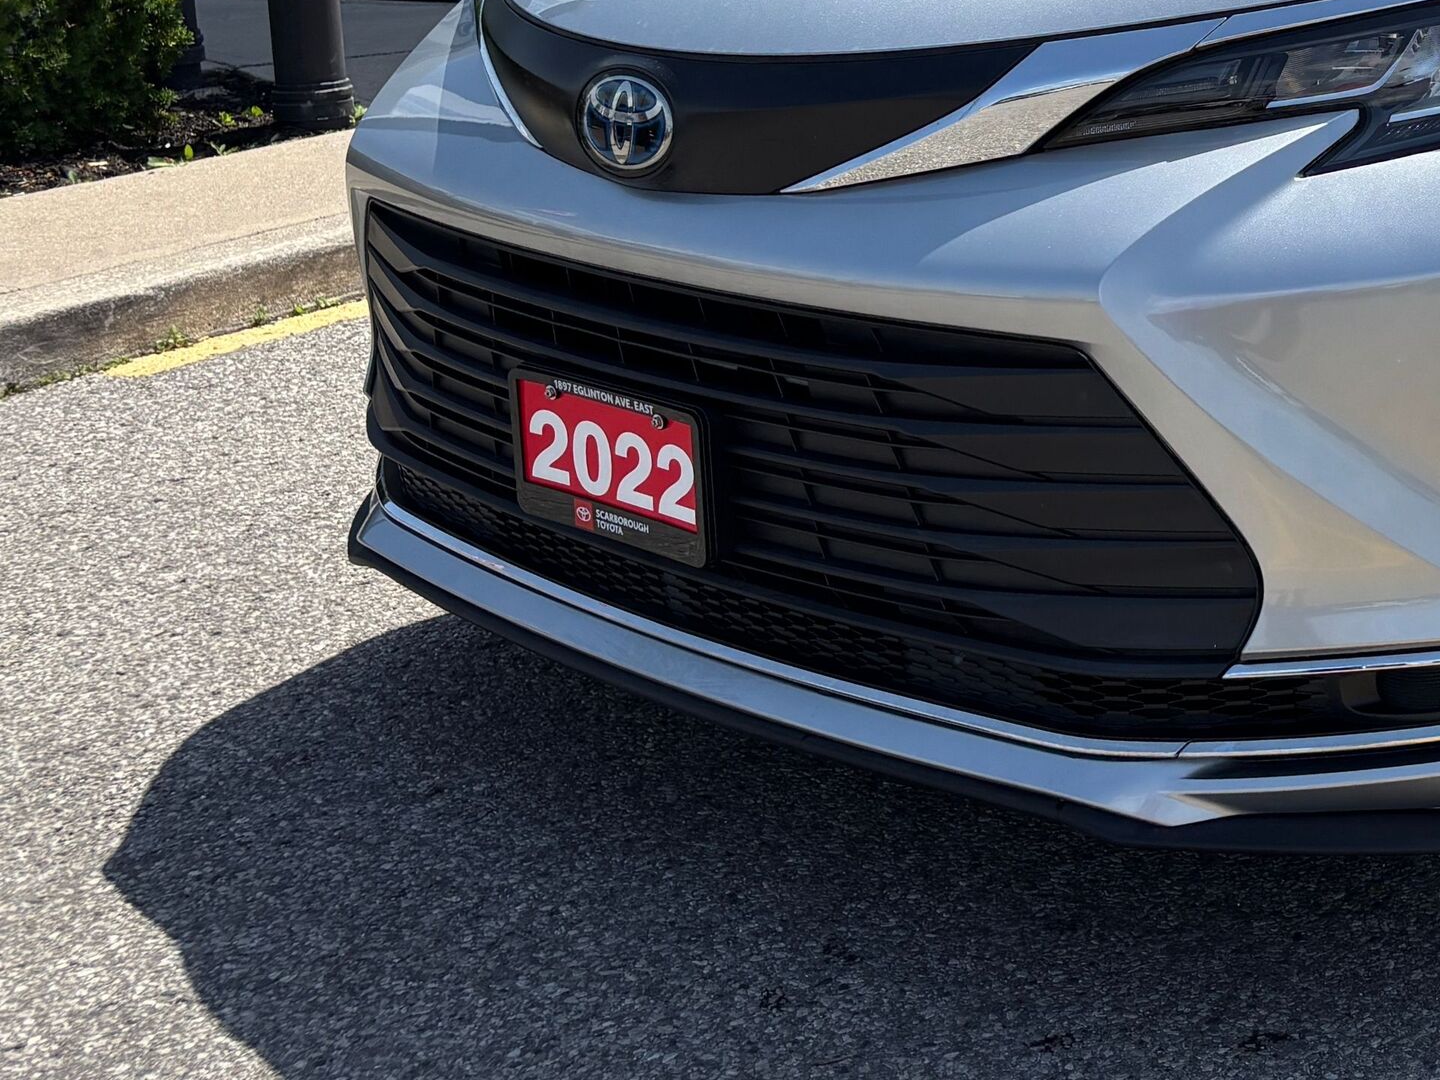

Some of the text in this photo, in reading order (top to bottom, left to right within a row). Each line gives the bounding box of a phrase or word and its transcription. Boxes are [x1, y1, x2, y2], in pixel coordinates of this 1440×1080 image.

[554, 379, 654, 416] 1897 EGLINTON AVE. EAST
[529, 409, 697, 526] 2022
[595, 508, 650, 534] SCARBOROUGH
[595, 518, 624, 536] TOYOTA
